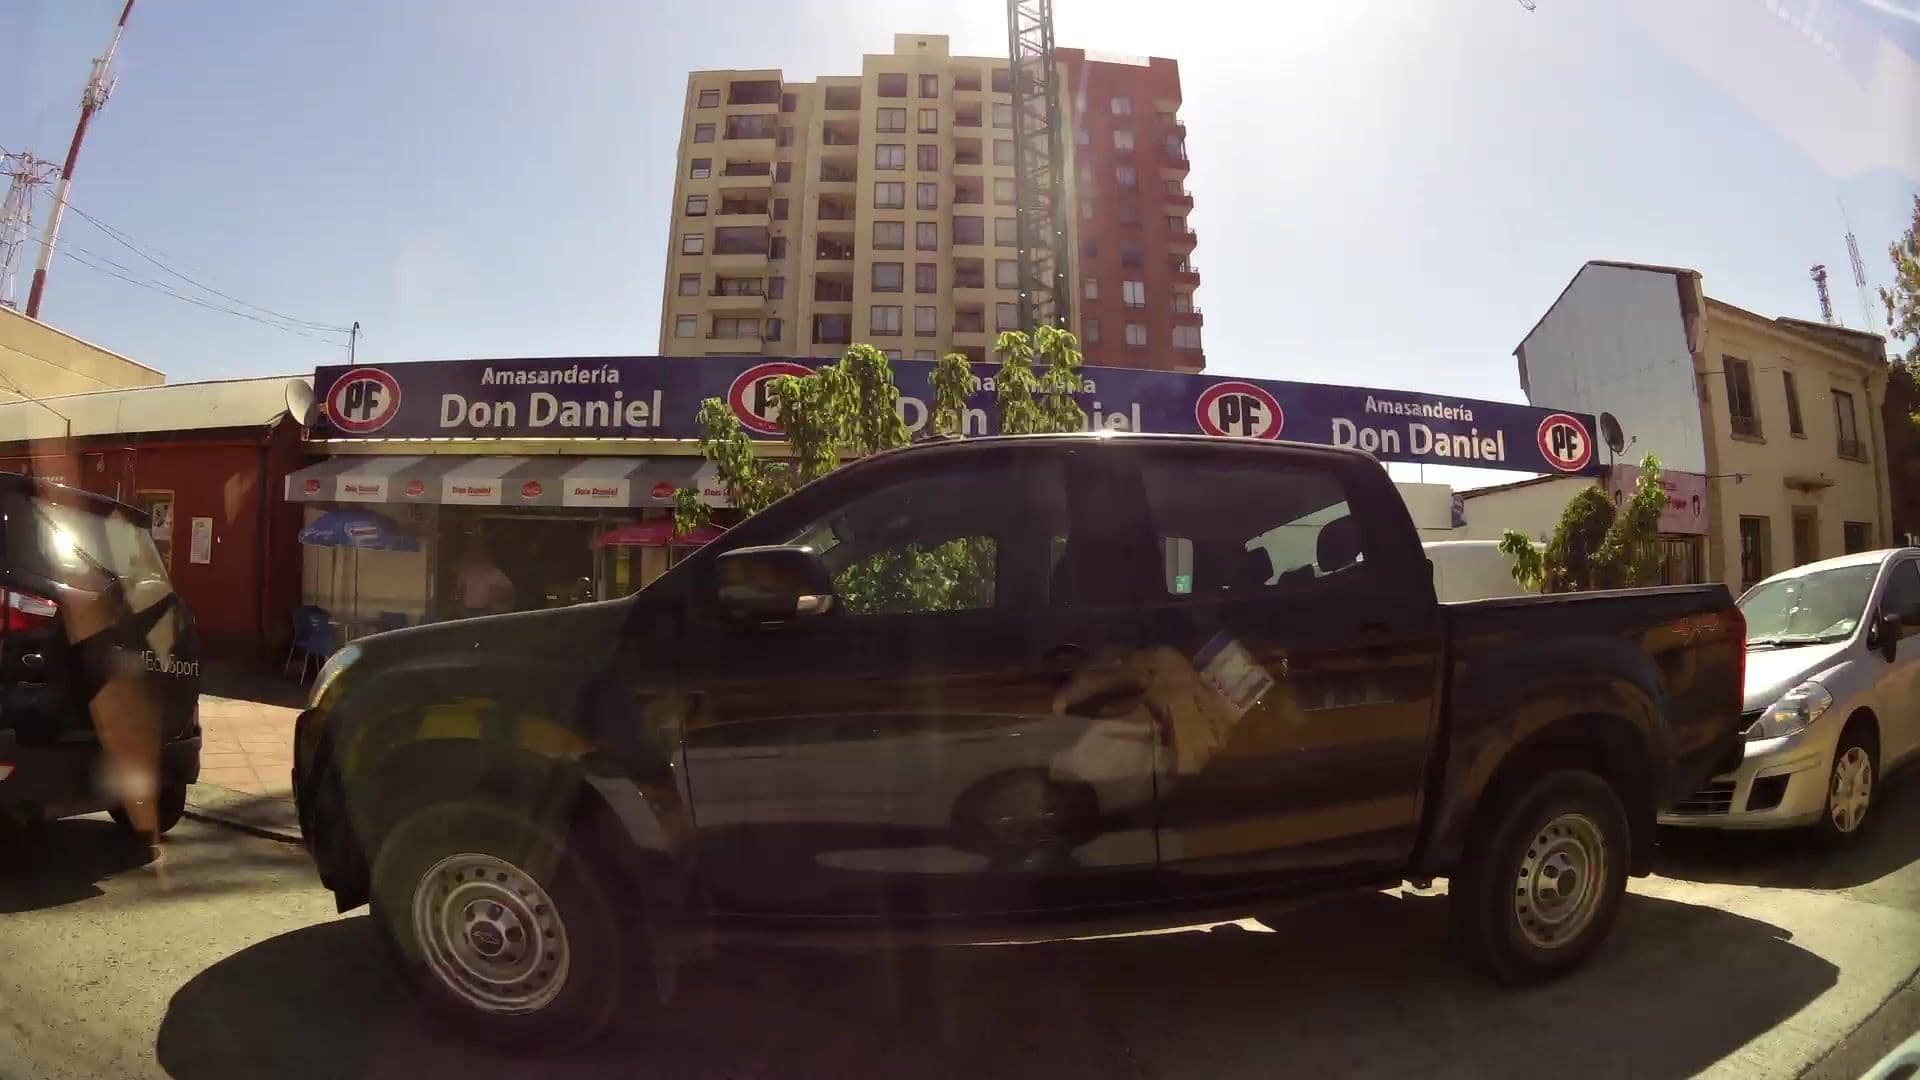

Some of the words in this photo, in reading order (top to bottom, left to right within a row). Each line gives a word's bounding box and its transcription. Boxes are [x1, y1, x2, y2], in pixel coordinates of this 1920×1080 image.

[482, 365, 619, 385] Amasandería
[345, 381, 383, 421] PF
[440, 393, 515, 427] Don
[528, 389, 662, 427] Daniel
[897, 396, 987, 438] Dn
[1218, 396, 1261, 437] PF
[1364, 394, 1473, 423] Amasandería
[1332, 418, 1400, 453] Don
[1408, 421, 1506, 463] Daniel
[1552, 424, 1579, 461] PF
